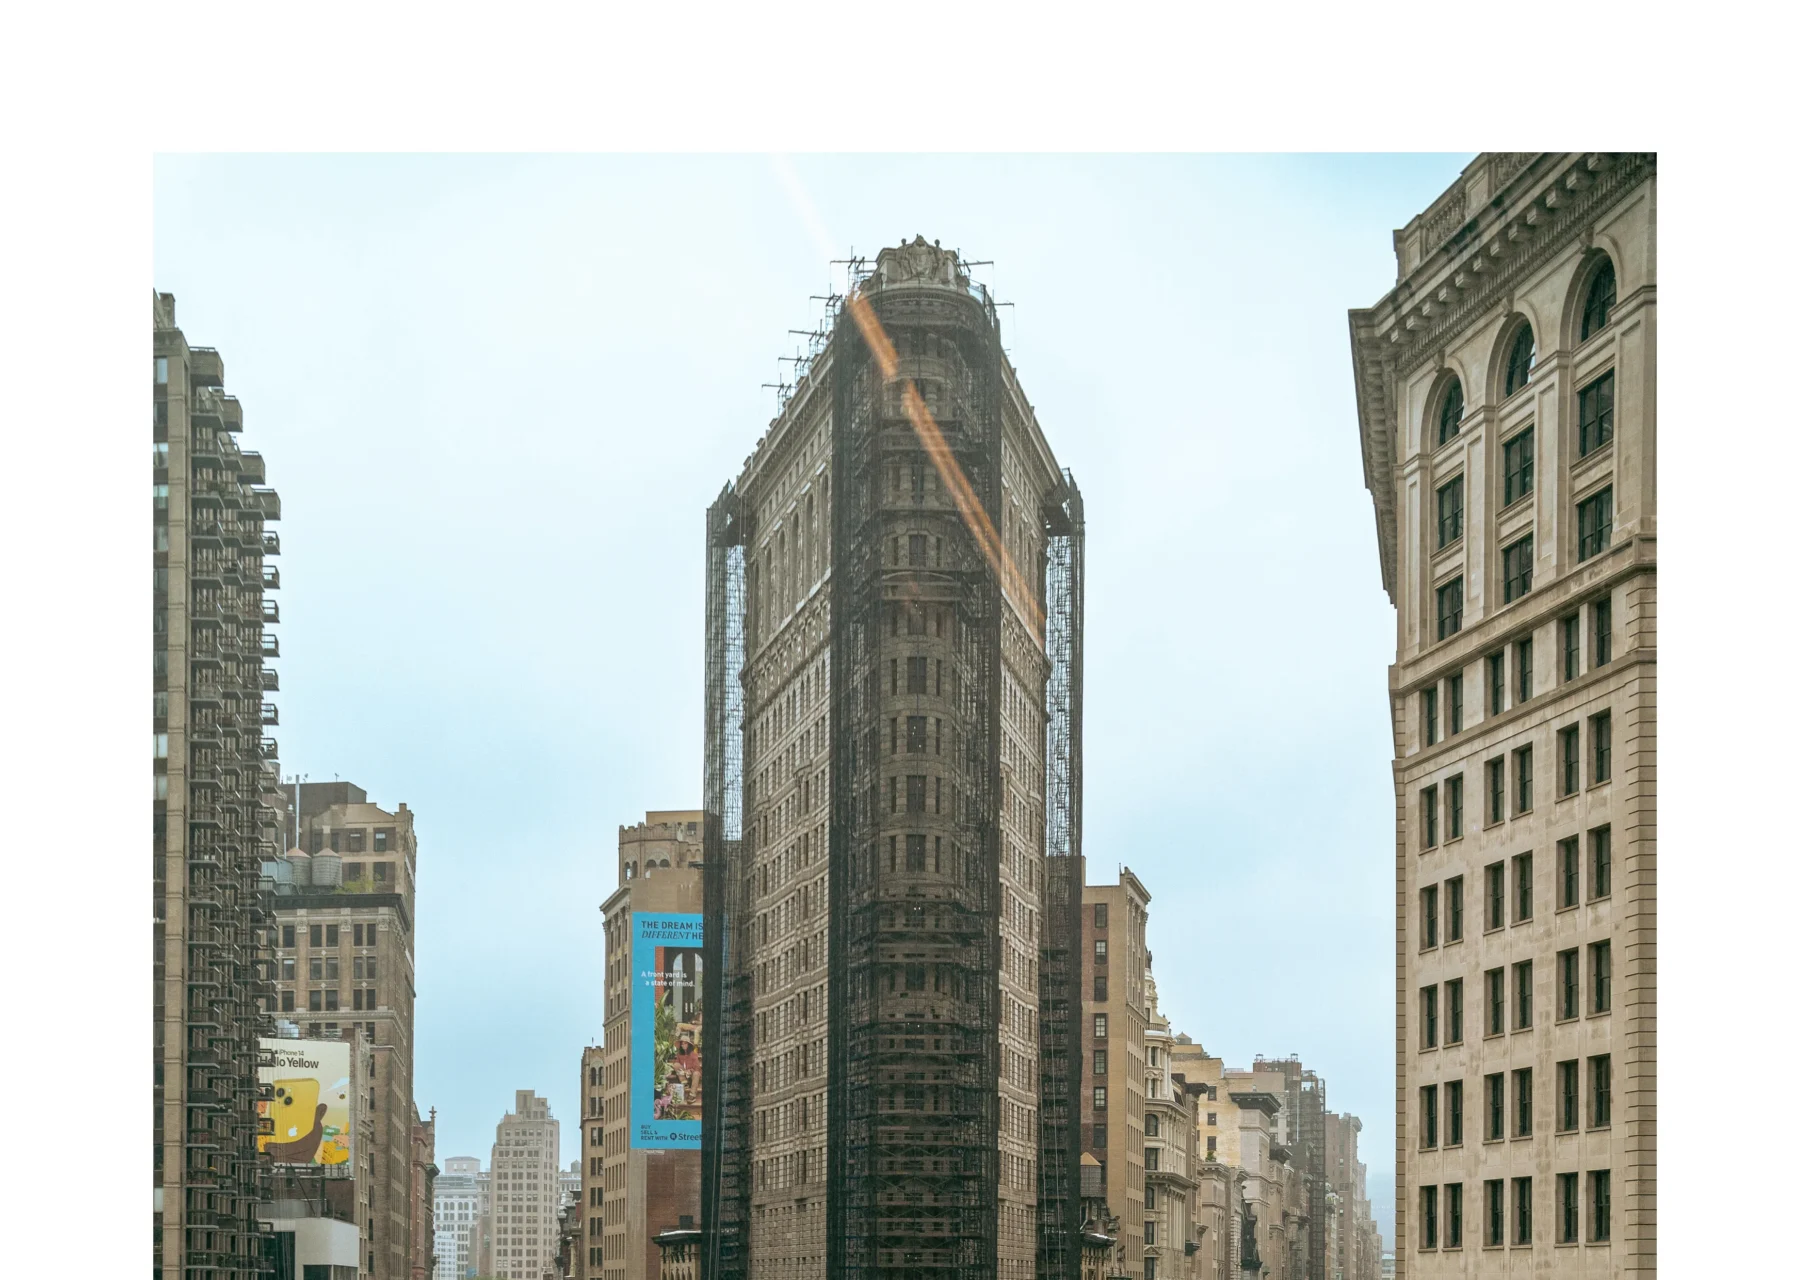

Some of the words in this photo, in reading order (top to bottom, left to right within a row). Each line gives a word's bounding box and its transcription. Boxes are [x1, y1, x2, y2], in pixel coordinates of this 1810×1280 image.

[641, 920, 659, 929] THE
[661, 921, 693, 930] DREAM
[641, 930, 691, 940] DIFFERENT
[647, 970, 664, 978] front
[665, 971, 680, 979] yard
[279, 1048, 298, 1056] iPhone
[260, 1055, 286, 1067] Helo
[286, 1056, 320, 1069] Yellow
